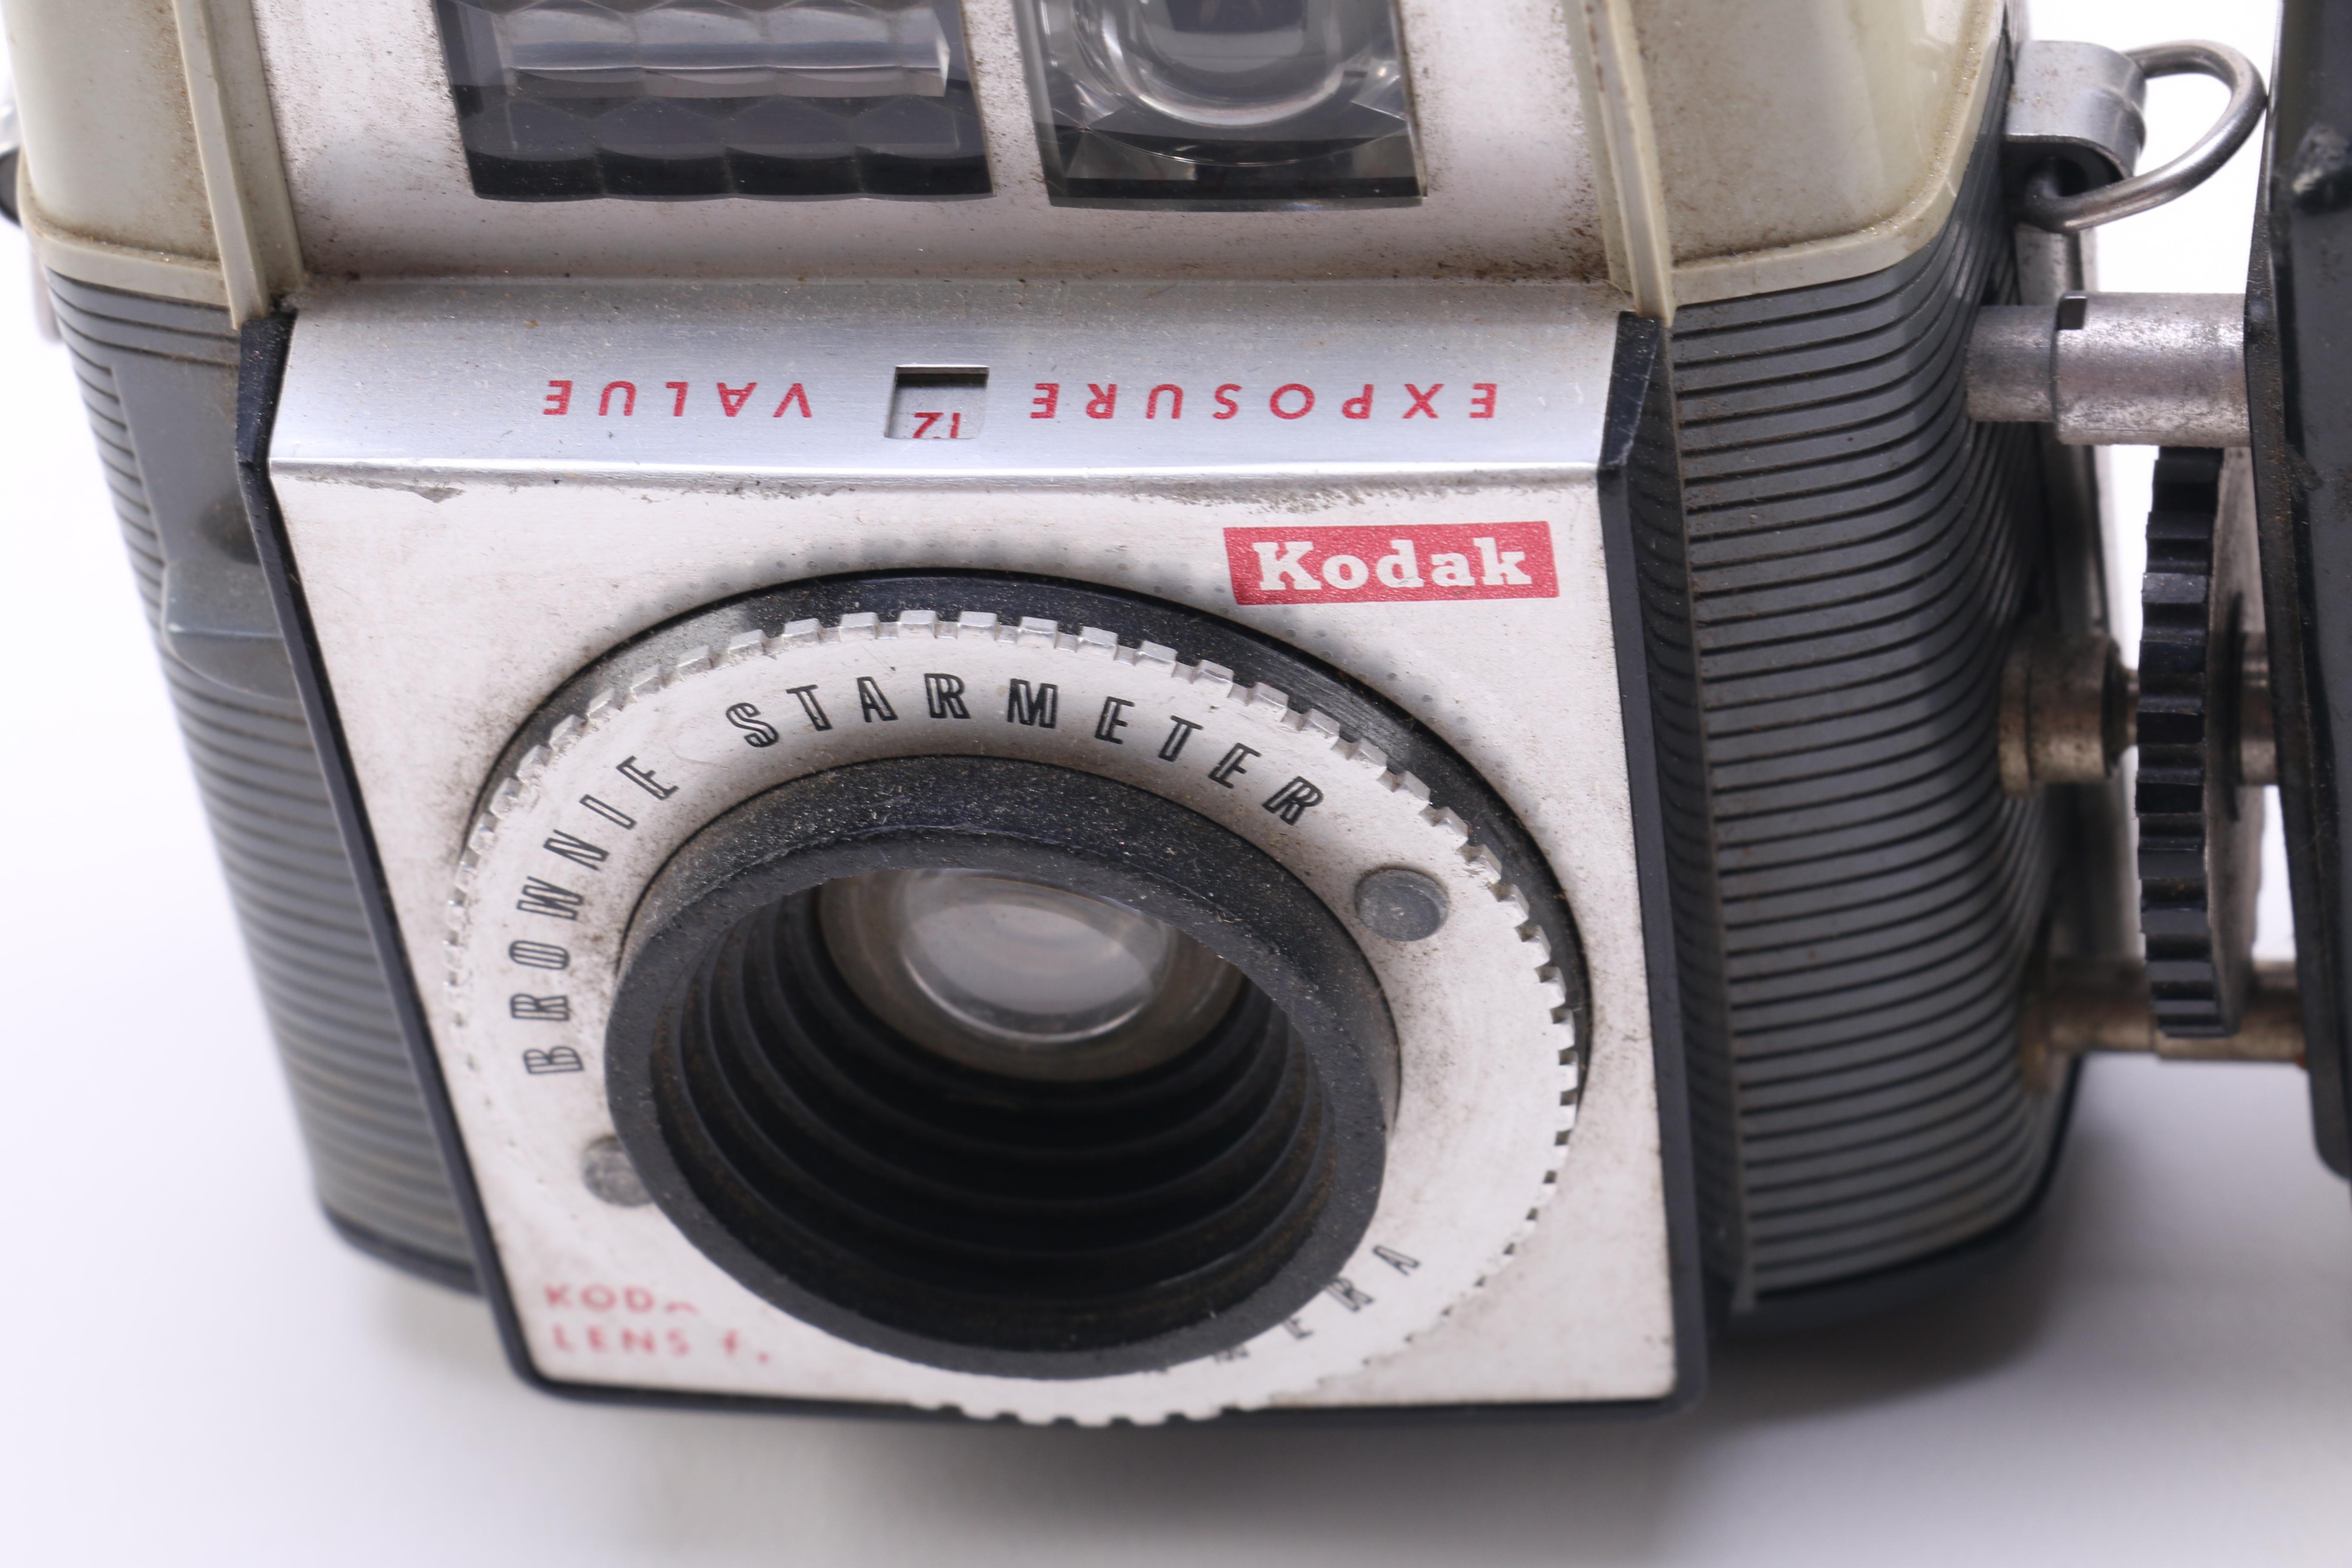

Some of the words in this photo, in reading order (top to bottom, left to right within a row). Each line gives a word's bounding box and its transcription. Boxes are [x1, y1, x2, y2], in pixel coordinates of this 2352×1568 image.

[542, 379, 812, 418] VALUE
[1029, 382, 1499, 420] EXPOSURE
[1252, 536, 1533, 591] Kodak
[508, 755, 680, 1075] BROWNIE
[725, 672, 1325, 827] STARMETER
[552, 1325, 690, 1357] LENS
